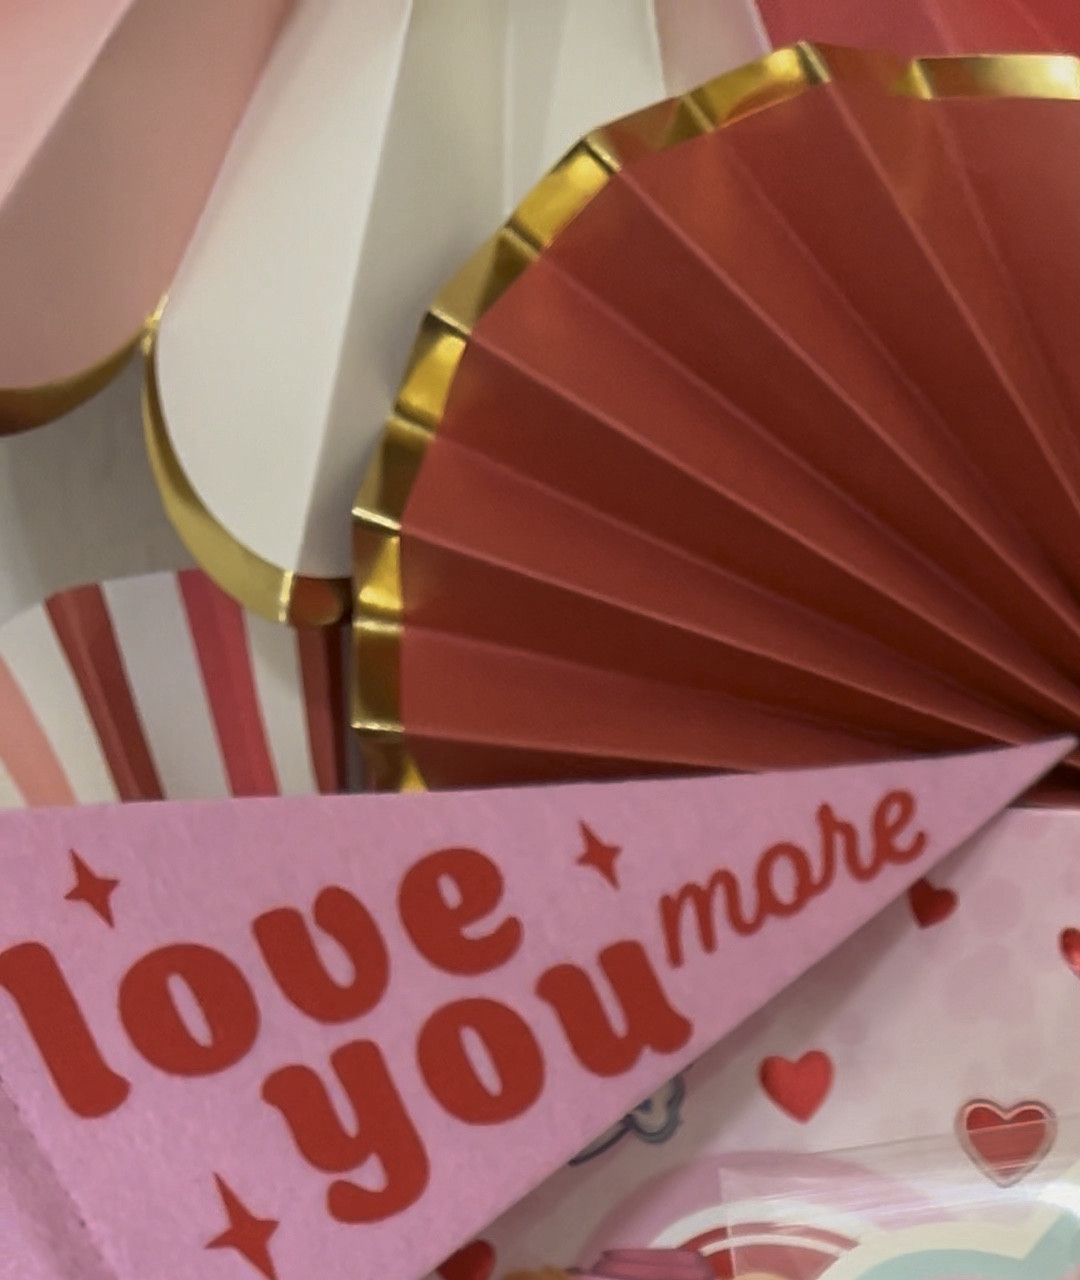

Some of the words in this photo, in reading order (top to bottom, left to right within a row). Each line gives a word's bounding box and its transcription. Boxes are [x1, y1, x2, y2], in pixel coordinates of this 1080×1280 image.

[0, 847, 524, 1120] love
[660, 789, 929, 970] more
[261, 938, 694, 1226] you
